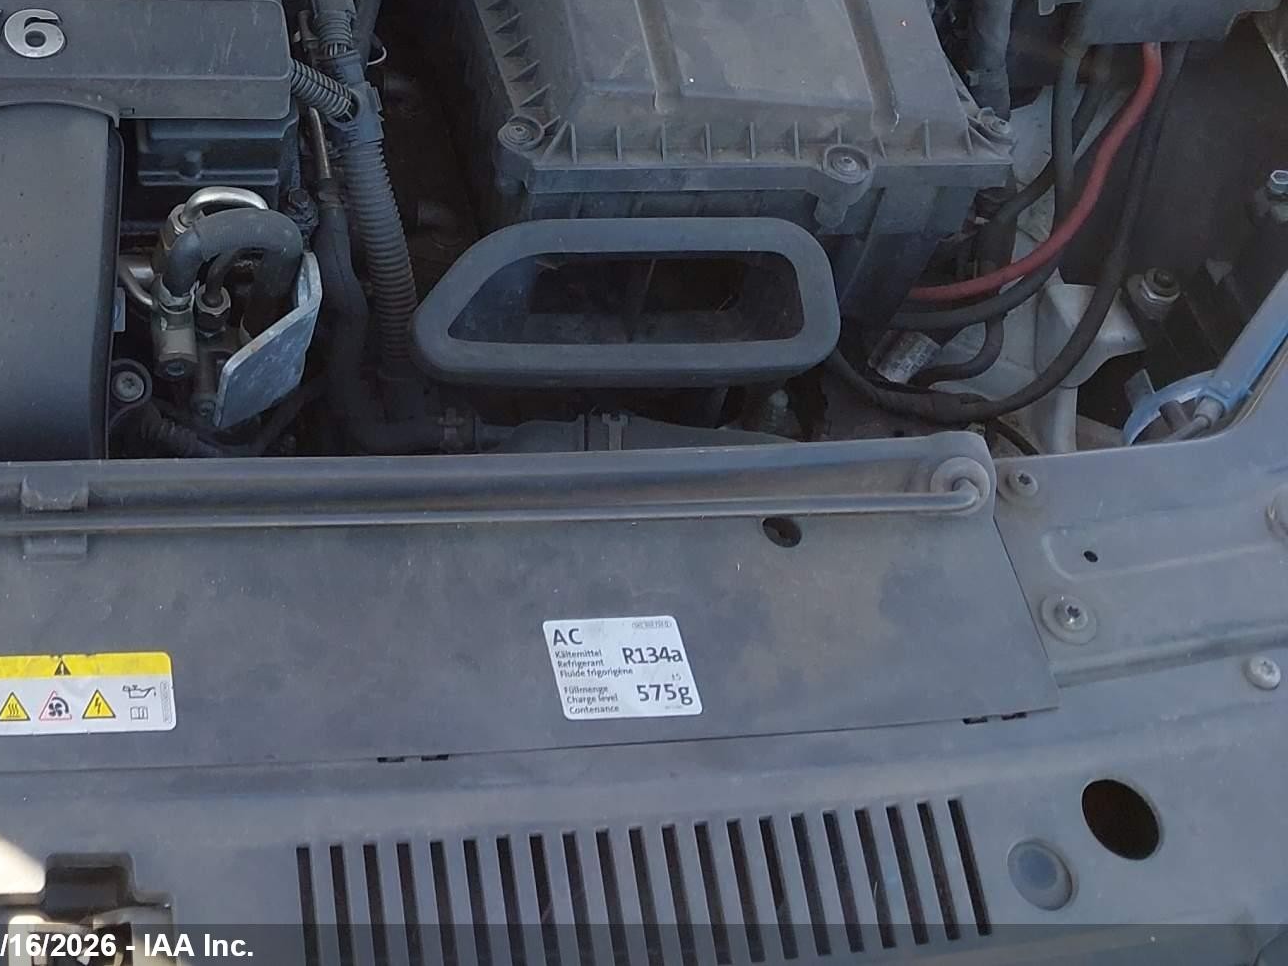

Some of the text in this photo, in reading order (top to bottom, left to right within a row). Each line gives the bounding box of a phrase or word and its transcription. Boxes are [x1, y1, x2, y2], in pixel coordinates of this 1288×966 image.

[553, 628, 583, 647] AC
[555, 649, 602, 659] Kältemittel
[621, 646, 684, 665] R134a
[557, 659, 605, 669] Refrigerant
[560, 668, 585, 678] Fluide
[567, 693, 618, 705] Charge level
[636, 684, 694, 706] 575g
[569, 706, 620, 715] Contenance
